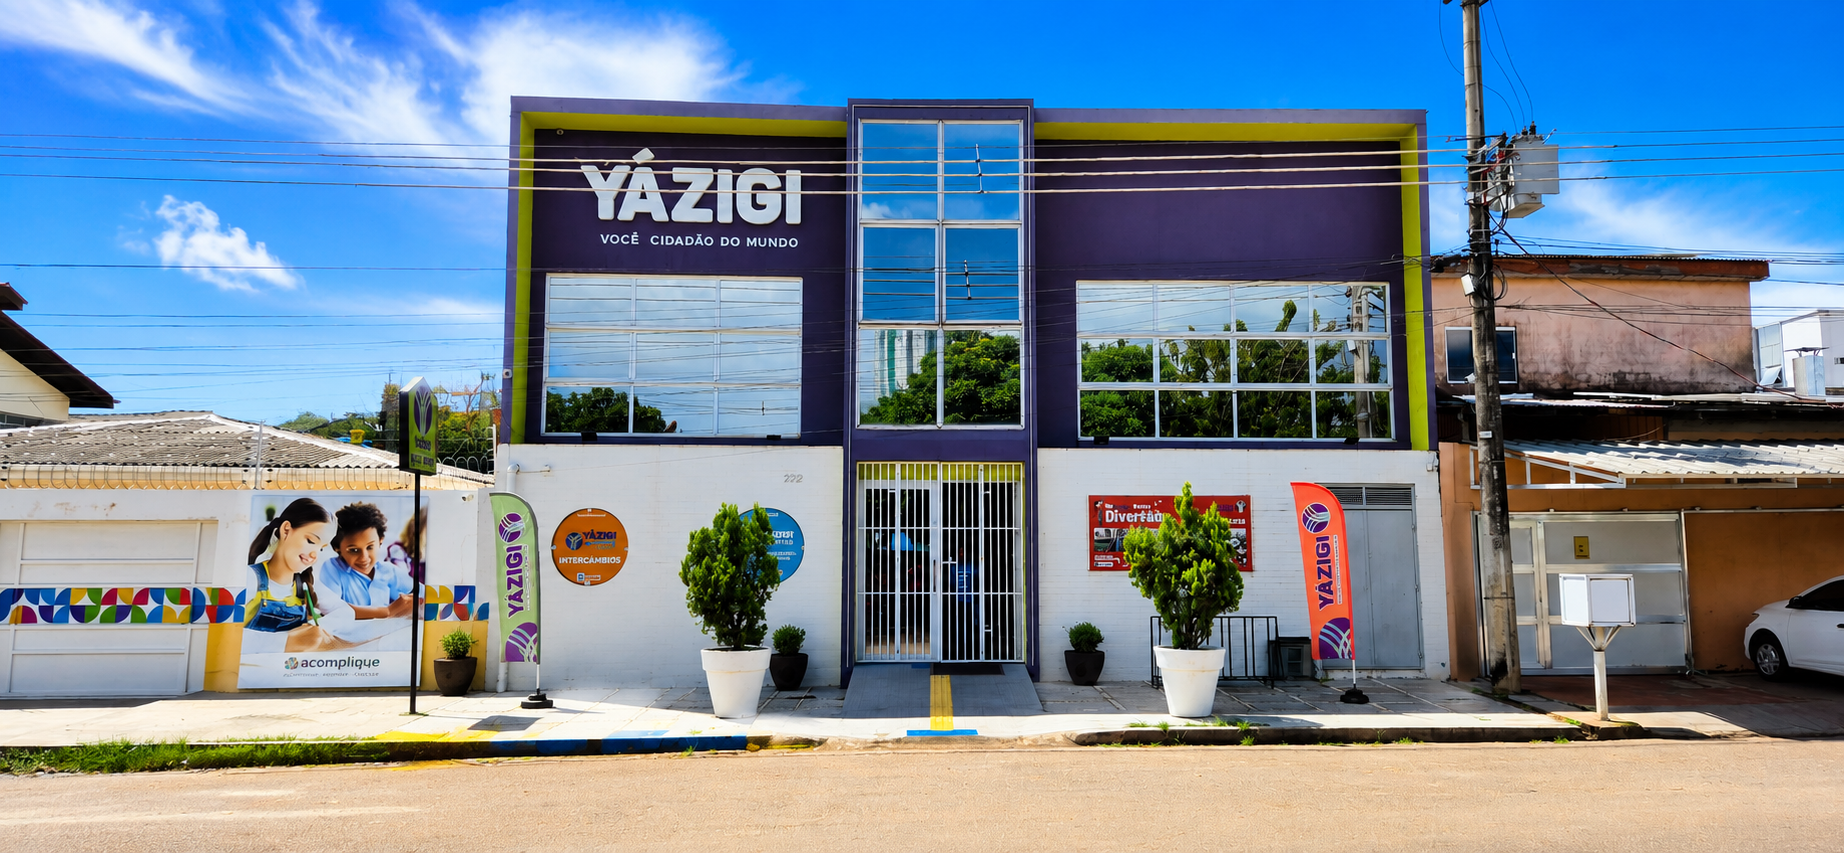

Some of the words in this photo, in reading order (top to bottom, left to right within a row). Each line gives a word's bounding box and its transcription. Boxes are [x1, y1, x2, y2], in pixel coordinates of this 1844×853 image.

[580, 147, 802, 225] YÁZIGI
[600, 231, 640, 245] VOCÊ
[650, 233, 714, 247] CIDADÃO
[720, 236, 741, 247] DO
[746, 237, 799, 248] MUNDO
[503, 544, 525, 619] YÁZIGI
[1315, 535, 1335, 611] YÁZIGI
[300, 656, 380, 670] acomplique
